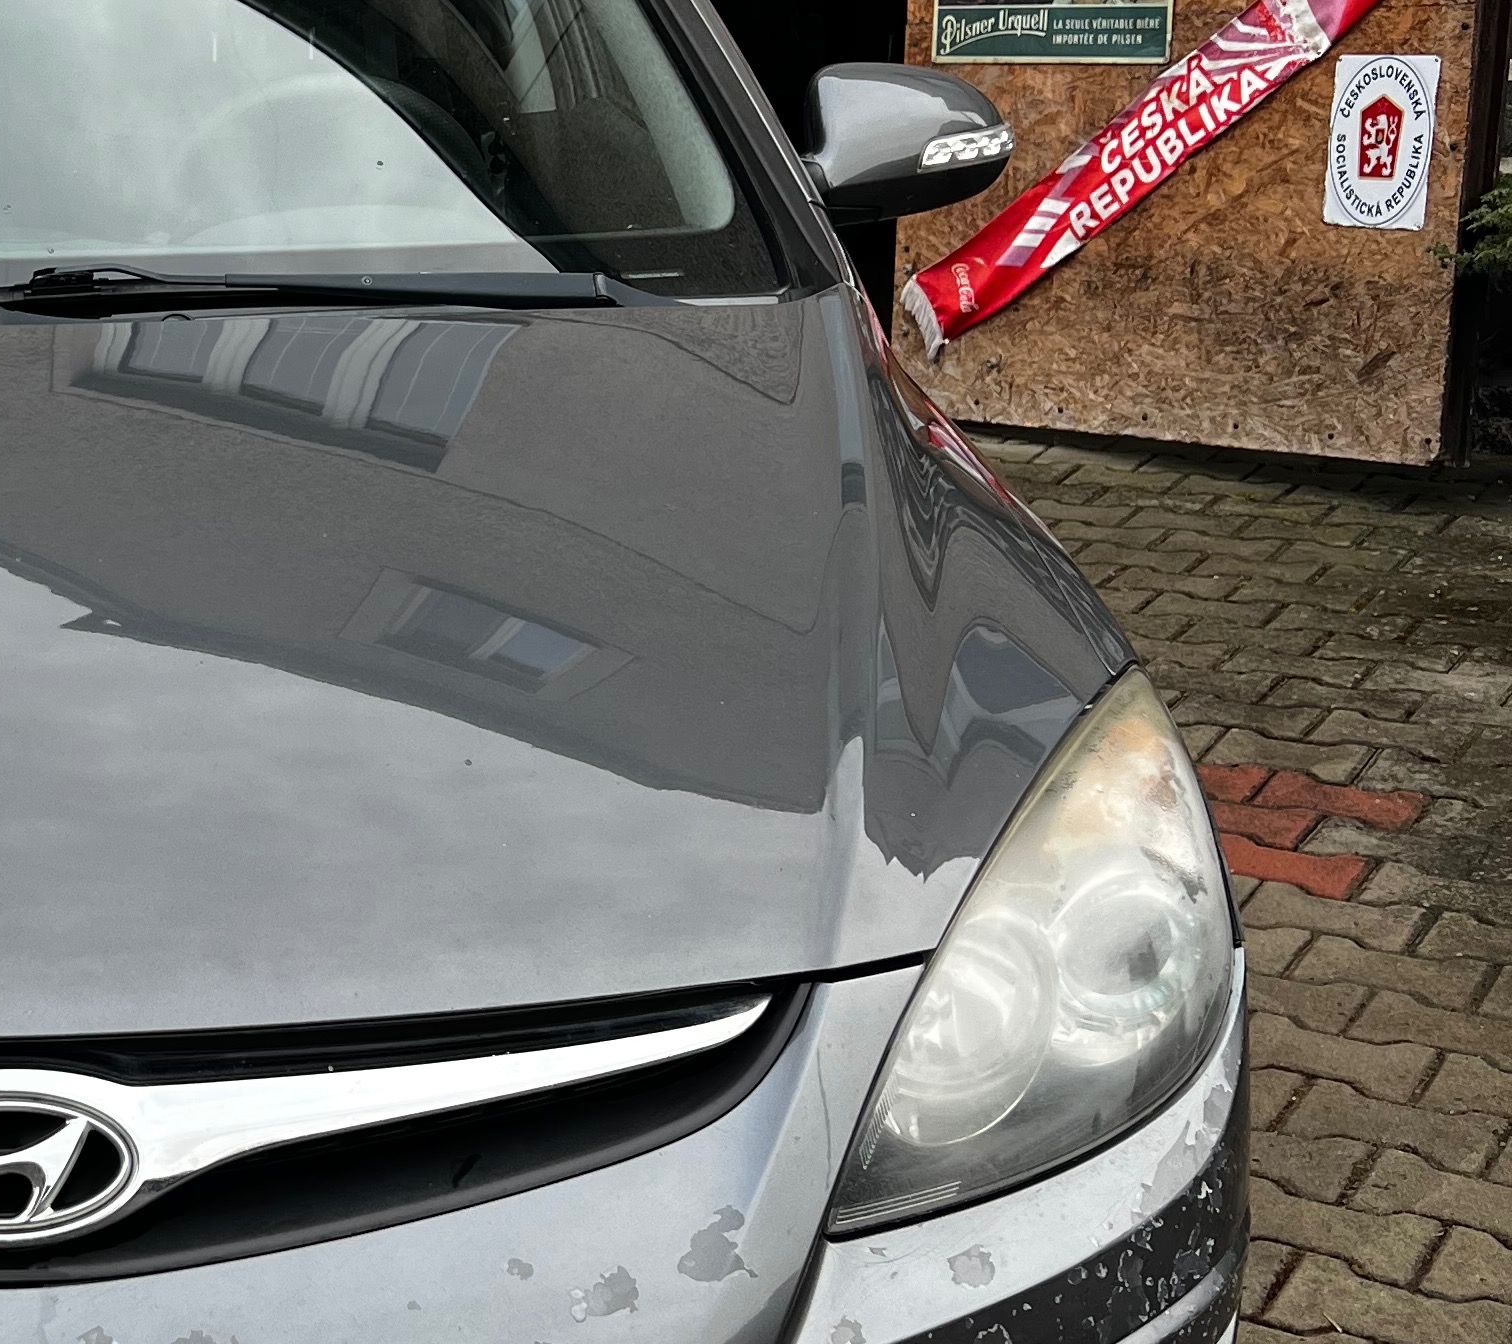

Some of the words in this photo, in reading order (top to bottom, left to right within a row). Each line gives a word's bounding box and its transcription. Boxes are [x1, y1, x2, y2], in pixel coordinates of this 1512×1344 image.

[940, 14, 995, 55] Pilsner
[998, 9, 1048, 37] Urquell
[1053, 19, 1063, 30] LA
[1065, 18, 1090, 30] SEULE
[1097, 34, 1107, 45] DE
[1112, 34, 1143, 45] PILSEN
[1099, 57, 1215, 174] ČESKÁ
[1340, 65, 1427, 121] ČESKOSLOVENSKÁ
[1069, 68, 1269, 238] REPUBLIKA
[1335, 133, 1383, 218] SOCIALISTICKÁ
[1385, 134, 1425, 213] REPUBLIKA
